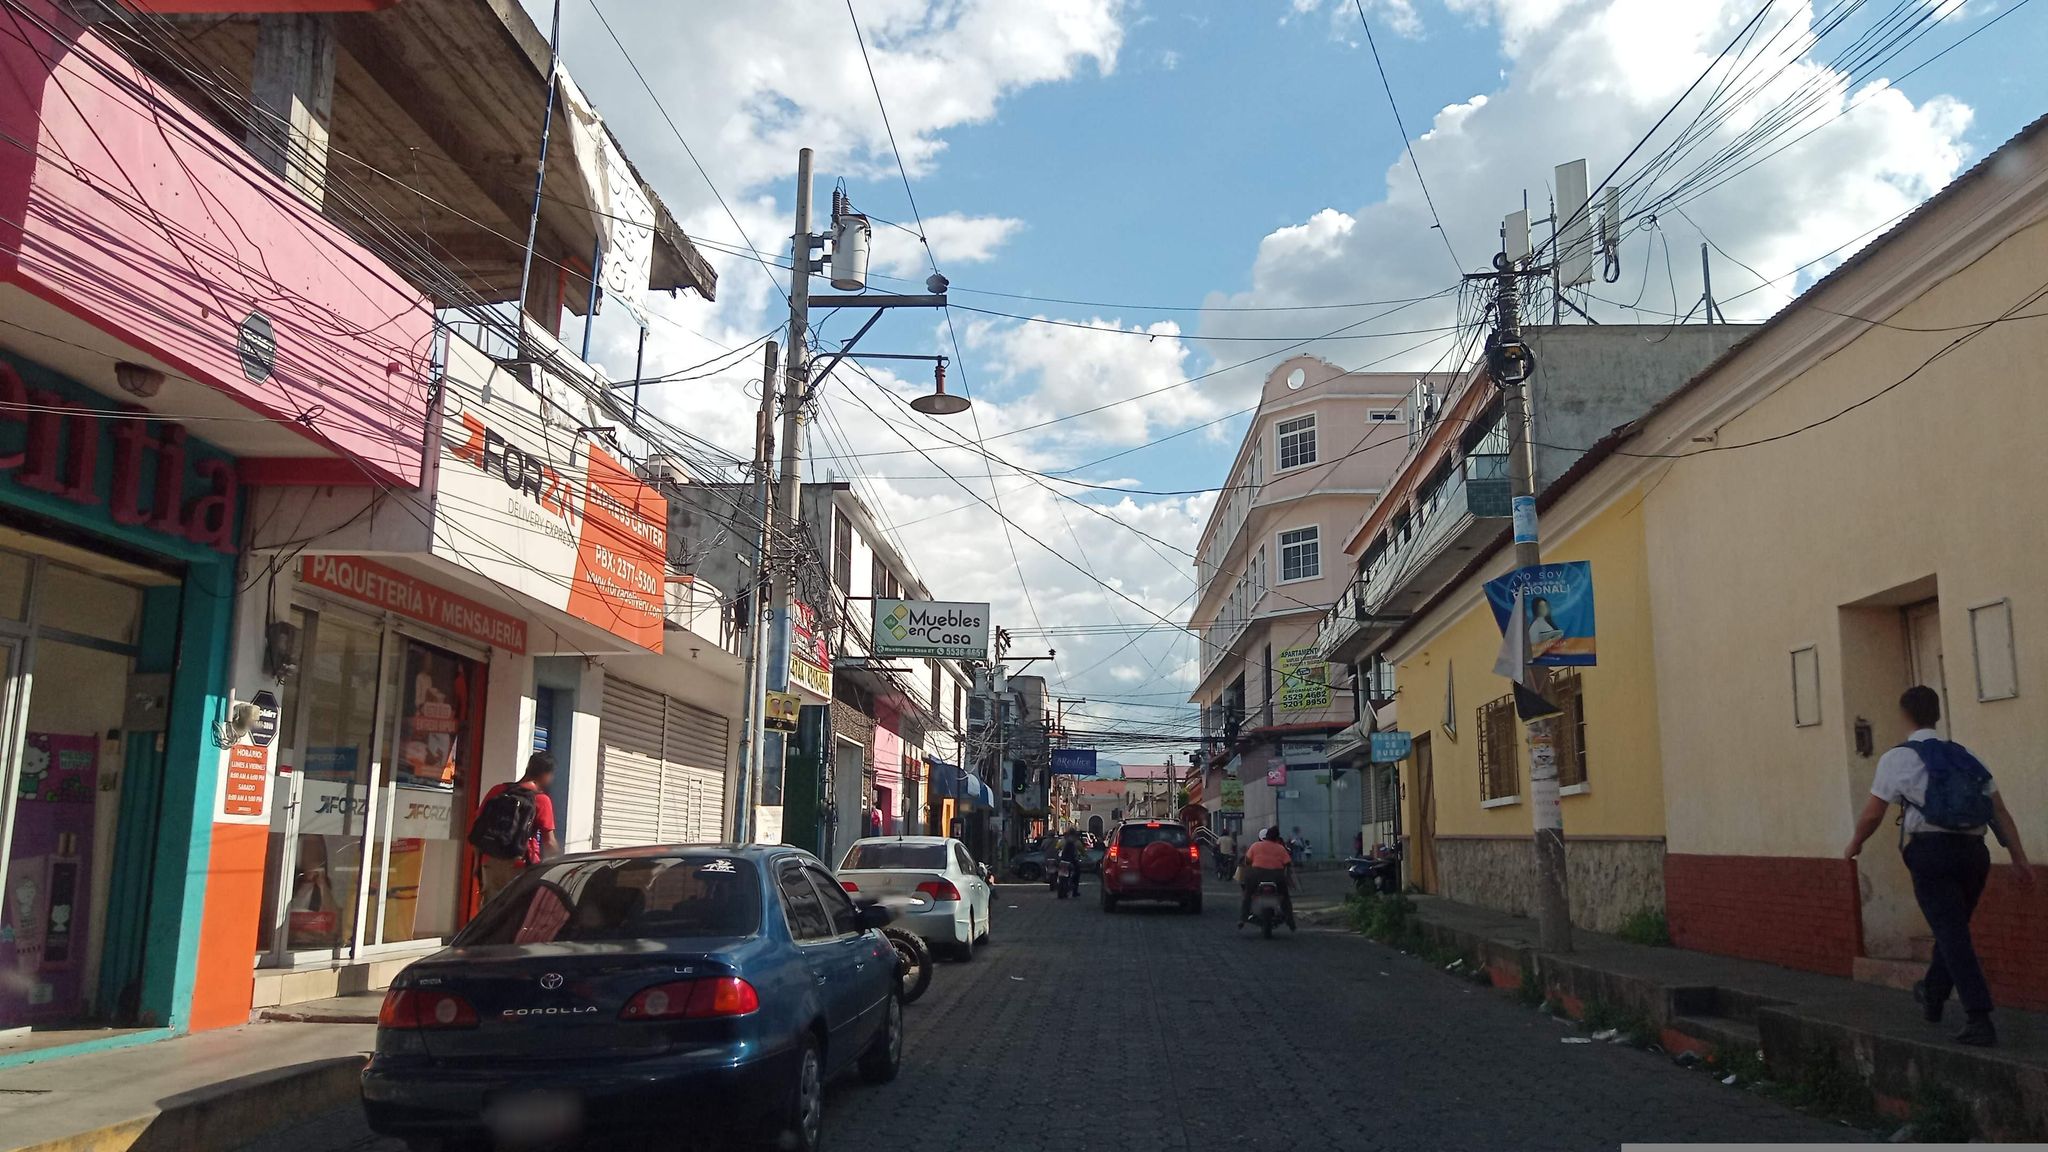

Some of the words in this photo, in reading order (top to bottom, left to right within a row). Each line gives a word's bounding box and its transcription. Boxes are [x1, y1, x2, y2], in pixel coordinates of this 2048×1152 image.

[483, 426, 575, 527] FORZA
[508, 498, 545, 531] DELIVERY
[545, 519, 575, 549] EXPRESS
[631, 511, 664, 550] CENTER
[595, 544, 617, 575] PBX:
[617, 557, 657, 596] 2377-5300
[312, 555, 424, 612] PAQUETERÍA
[427, 595, 438, 618] Y
[441, 600, 523, 650] MENSAJERÍA
[909, 608, 981, 628] Muebles
[908, 627, 926, 636] en
[926, 626, 971, 645] Casa
[330, 796, 367, 816] FORZ
[674, 966, 694, 974] LE
[503, 1006, 598, 1016] COROLLA
